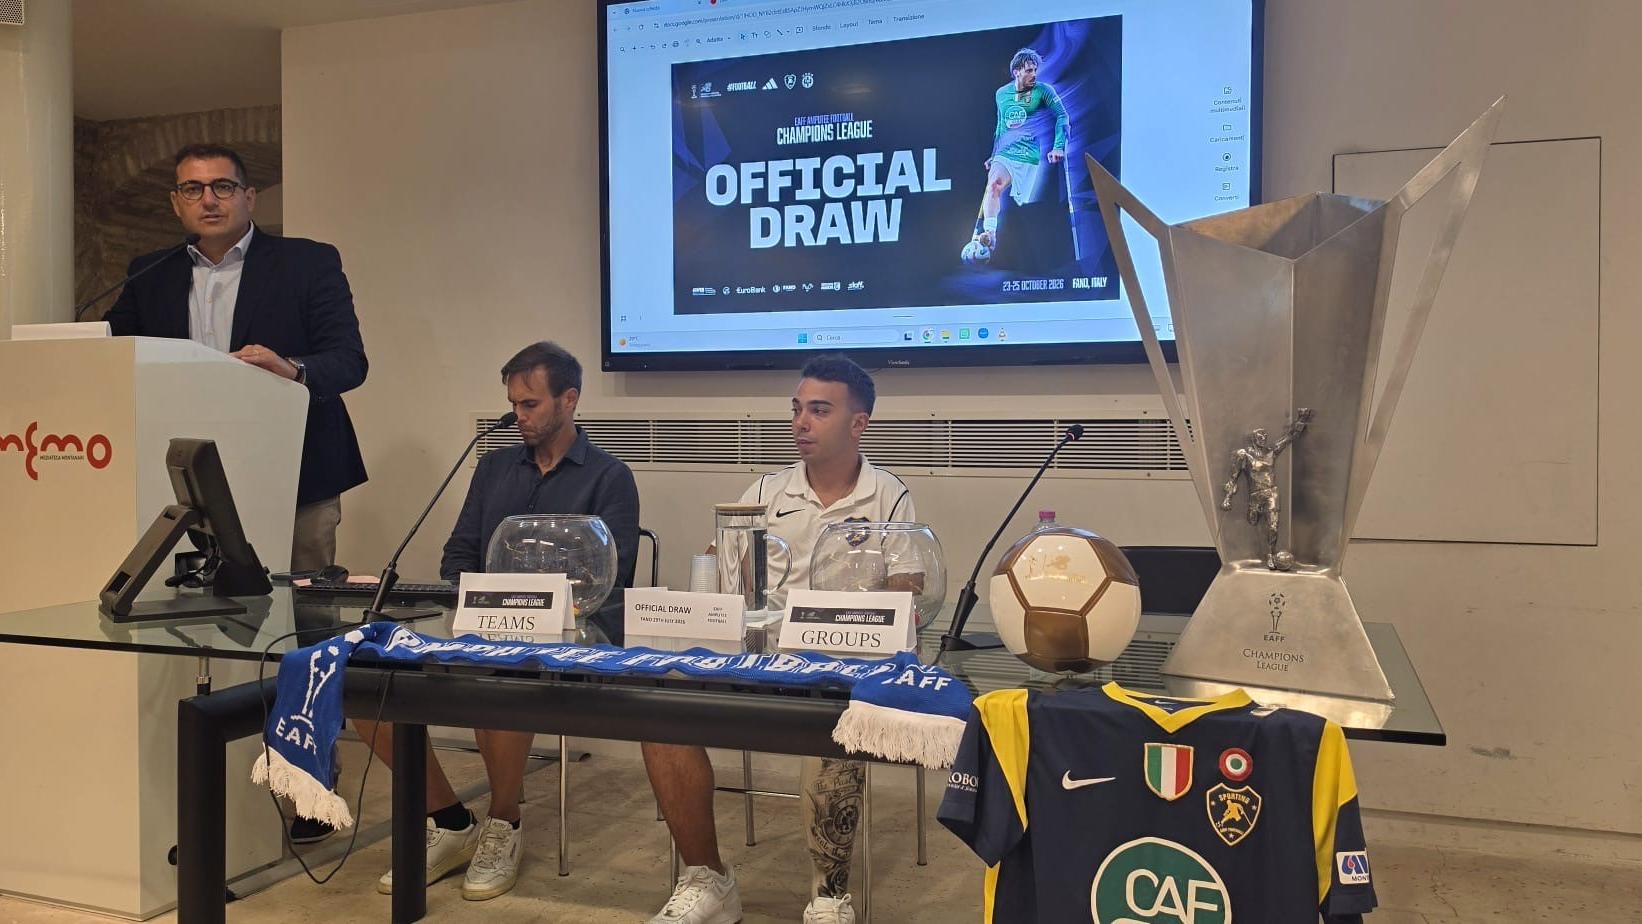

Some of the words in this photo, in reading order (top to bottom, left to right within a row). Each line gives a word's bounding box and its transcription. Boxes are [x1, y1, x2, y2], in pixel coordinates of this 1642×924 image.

[776, 123, 834, 145] CHAMPIONS
[836, 120, 873, 141] LEAGUE
[705, 148, 951, 206] OFFICIAL
[750, 198, 903, 249] DRAW
[1021, 280, 1047, 291] OCTOBER
[1091, 276, 1107, 288] ITALY
[502, 598, 528, 606] CHAMPIONS
[635, 603, 667, 613] OFFICIAL
[668, 605, 692, 614] DRAW
[477, 615, 535, 631] TEAMS
[835, 614, 866, 623] CHAMPIONS
[866, 615, 885, 623] LEAGUE
[801, 630, 881, 648] GROUPS
[1263, 634, 1285, 642] EAFF
[1243, 649, 1304, 663] CHAMPIONS
[1256, 661, 1289, 672] LEAGUE
